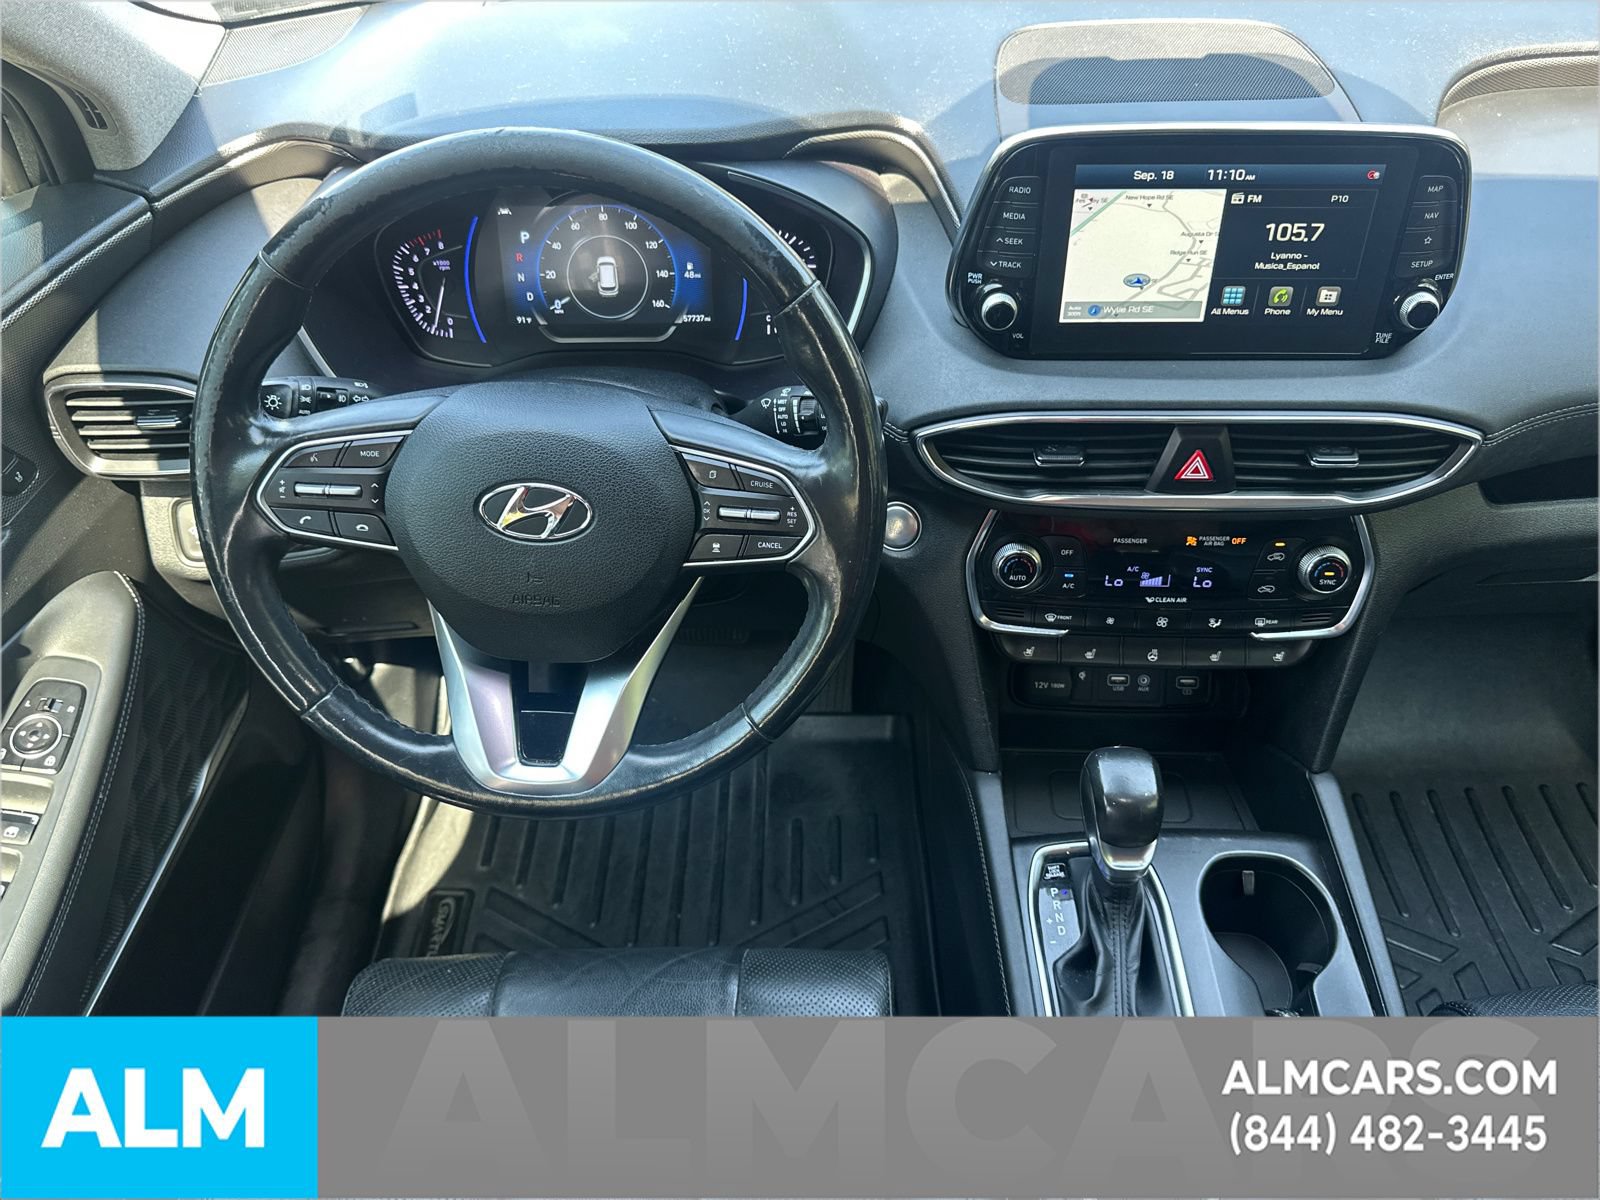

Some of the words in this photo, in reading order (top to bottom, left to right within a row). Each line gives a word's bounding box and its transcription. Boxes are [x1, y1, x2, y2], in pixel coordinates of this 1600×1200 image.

[1133, 170, 1157, 181] Sep.
[1161, 170, 1174, 180] 18
[1009, 186, 1031, 194] RADIO
[1247, 195, 1262, 203] FM
[1331, 195, 1349, 203] P10
[598, 213, 607, 221] 80
[1003, 212, 1025, 220] MEDIA
[571, 223, 580, 231] 60
[624, 222, 637, 230] 100
[1266, 223, 1325, 242] 105.7
[520, 232, 529, 243] P
[1004, 237, 1023, 245] SEEK
[438, 241, 444, 249] 8
[552, 243, 561, 251] 40
[646, 241, 657, 250] 120
[424, 247, 430, 255] 7
[516, 253, 523, 262] R
[1270, 252, 1302, 260] Lyanno
[998, 260, 1021, 269] TRACK
[1254, 262, 1320, 271] Musica_Espanol
[1410, 260, 1433, 268] SETUP
[408, 268, 414, 276] 5
[546, 271, 556, 279] 20
[656, 270, 669, 278] 140
[518, 273, 525, 282] N
[526, 292, 534, 301] D
[554, 299, 561, 309] 0
[1104, 306, 1126, 315] Wylie
[1306, 308, 1319, 317] My
[750, 480, 773, 488] CRUISE
[1231, 537, 1248, 545] OFF
[1104, 575, 1123, 587] Lo
[1193, 576, 1212, 588] Lo
[1034, 681, 1049, 689] 12V
[1051, 888, 1058, 897] P
[1053, 901, 1061, 910] R
[1055, 913, 1064, 922] N
[1058, 926, 1066, 935] D
